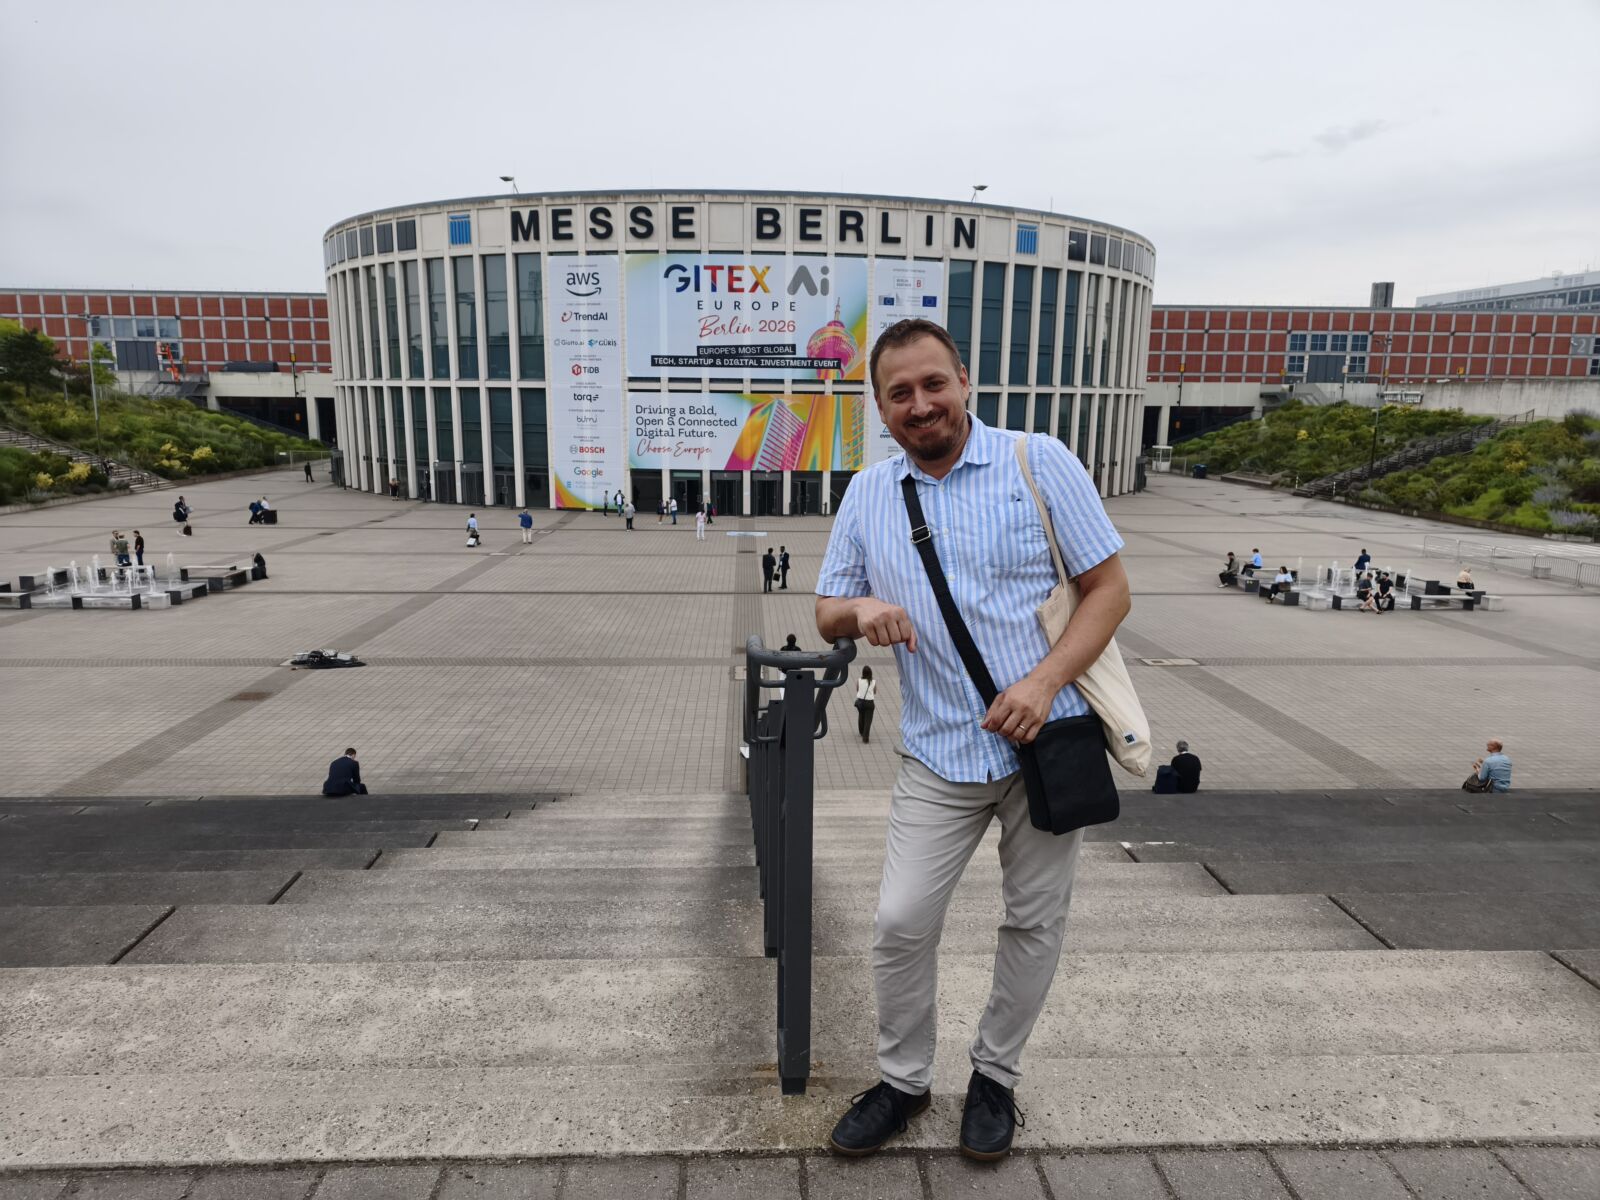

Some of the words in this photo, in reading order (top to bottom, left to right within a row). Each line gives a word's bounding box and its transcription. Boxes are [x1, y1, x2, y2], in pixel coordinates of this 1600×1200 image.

[511, 206, 696, 242] MESSE
[756, 207, 976, 249] BERLIN
[566, 271, 600, 286] aws
[663, 264, 771, 294] GITEX
[787, 264, 830, 297] Ai
[697, 300, 797, 312] EUROPE
[573, 312, 608, 321] TrendAI
[698, 314, 754, 338] Berlin
[758, 319, 797, 333] 2026
[699, 346, 737, 355] EUROPE'S
[738, 346, 761, 354] MOST
[763, 345, 794, 354] GLOBAL
[654, 357, 676, 366] TECH,
[678, 358, 714, 366] STARTUP
[715, 358, 722, 366] &
[723, 358, 758, 366] DIGITAL
[760, 359, 811, 367] INVESTMENT
[813, 360, 839, 368] EVENT
[583, 366, 600, 374] TiDB
[573, 392, 593, 403] torq
[635, 404, 676, 417] Driving
[679, 407, 686, 415] a
[688, 405, 718, 416] Bold,
[635, 416, 664, 427] Open
[666, 416, 676, 427] &
[678, 416, 738, 427] Connected
[636, 427, 675, 440] Digital
[678, 428, 718, 438] Future.
[578, 446, 605, 454] BOSCH
[636, 438, 673, 457] Choose
[573, 466, 604, 478] Google
